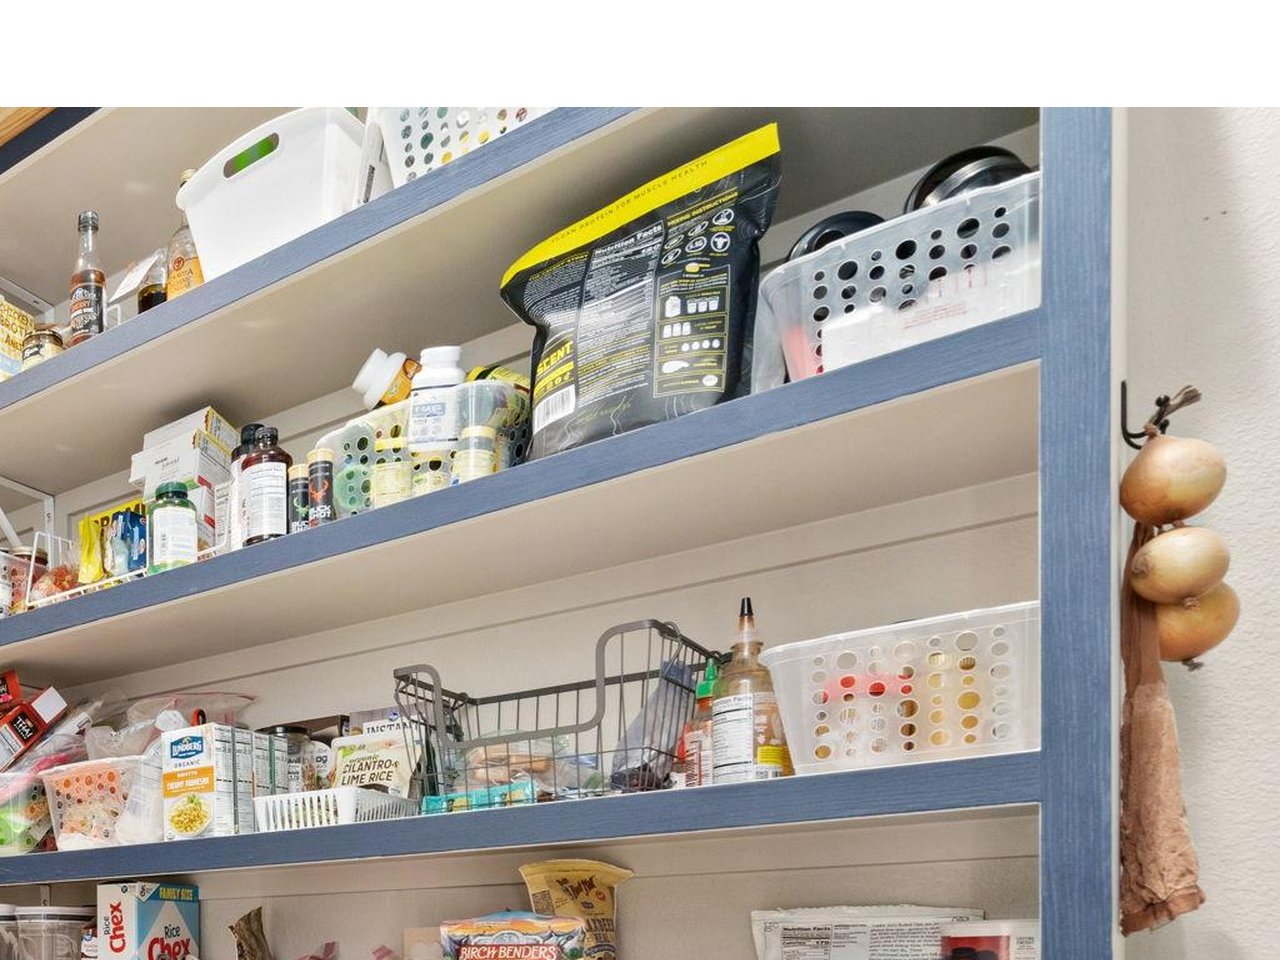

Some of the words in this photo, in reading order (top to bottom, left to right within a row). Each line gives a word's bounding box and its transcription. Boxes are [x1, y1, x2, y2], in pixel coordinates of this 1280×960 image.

[0, 315, 26, 335] BROT
[536, 340, 574, 376] SCENT
[341, 774, 367, 786] LIME
[368, 769, 394, 783] RICE
[103, 916, 111, 936] Rice
[109, 901, 126, 953] Chex
[164, 924, 181, 939] Rice
